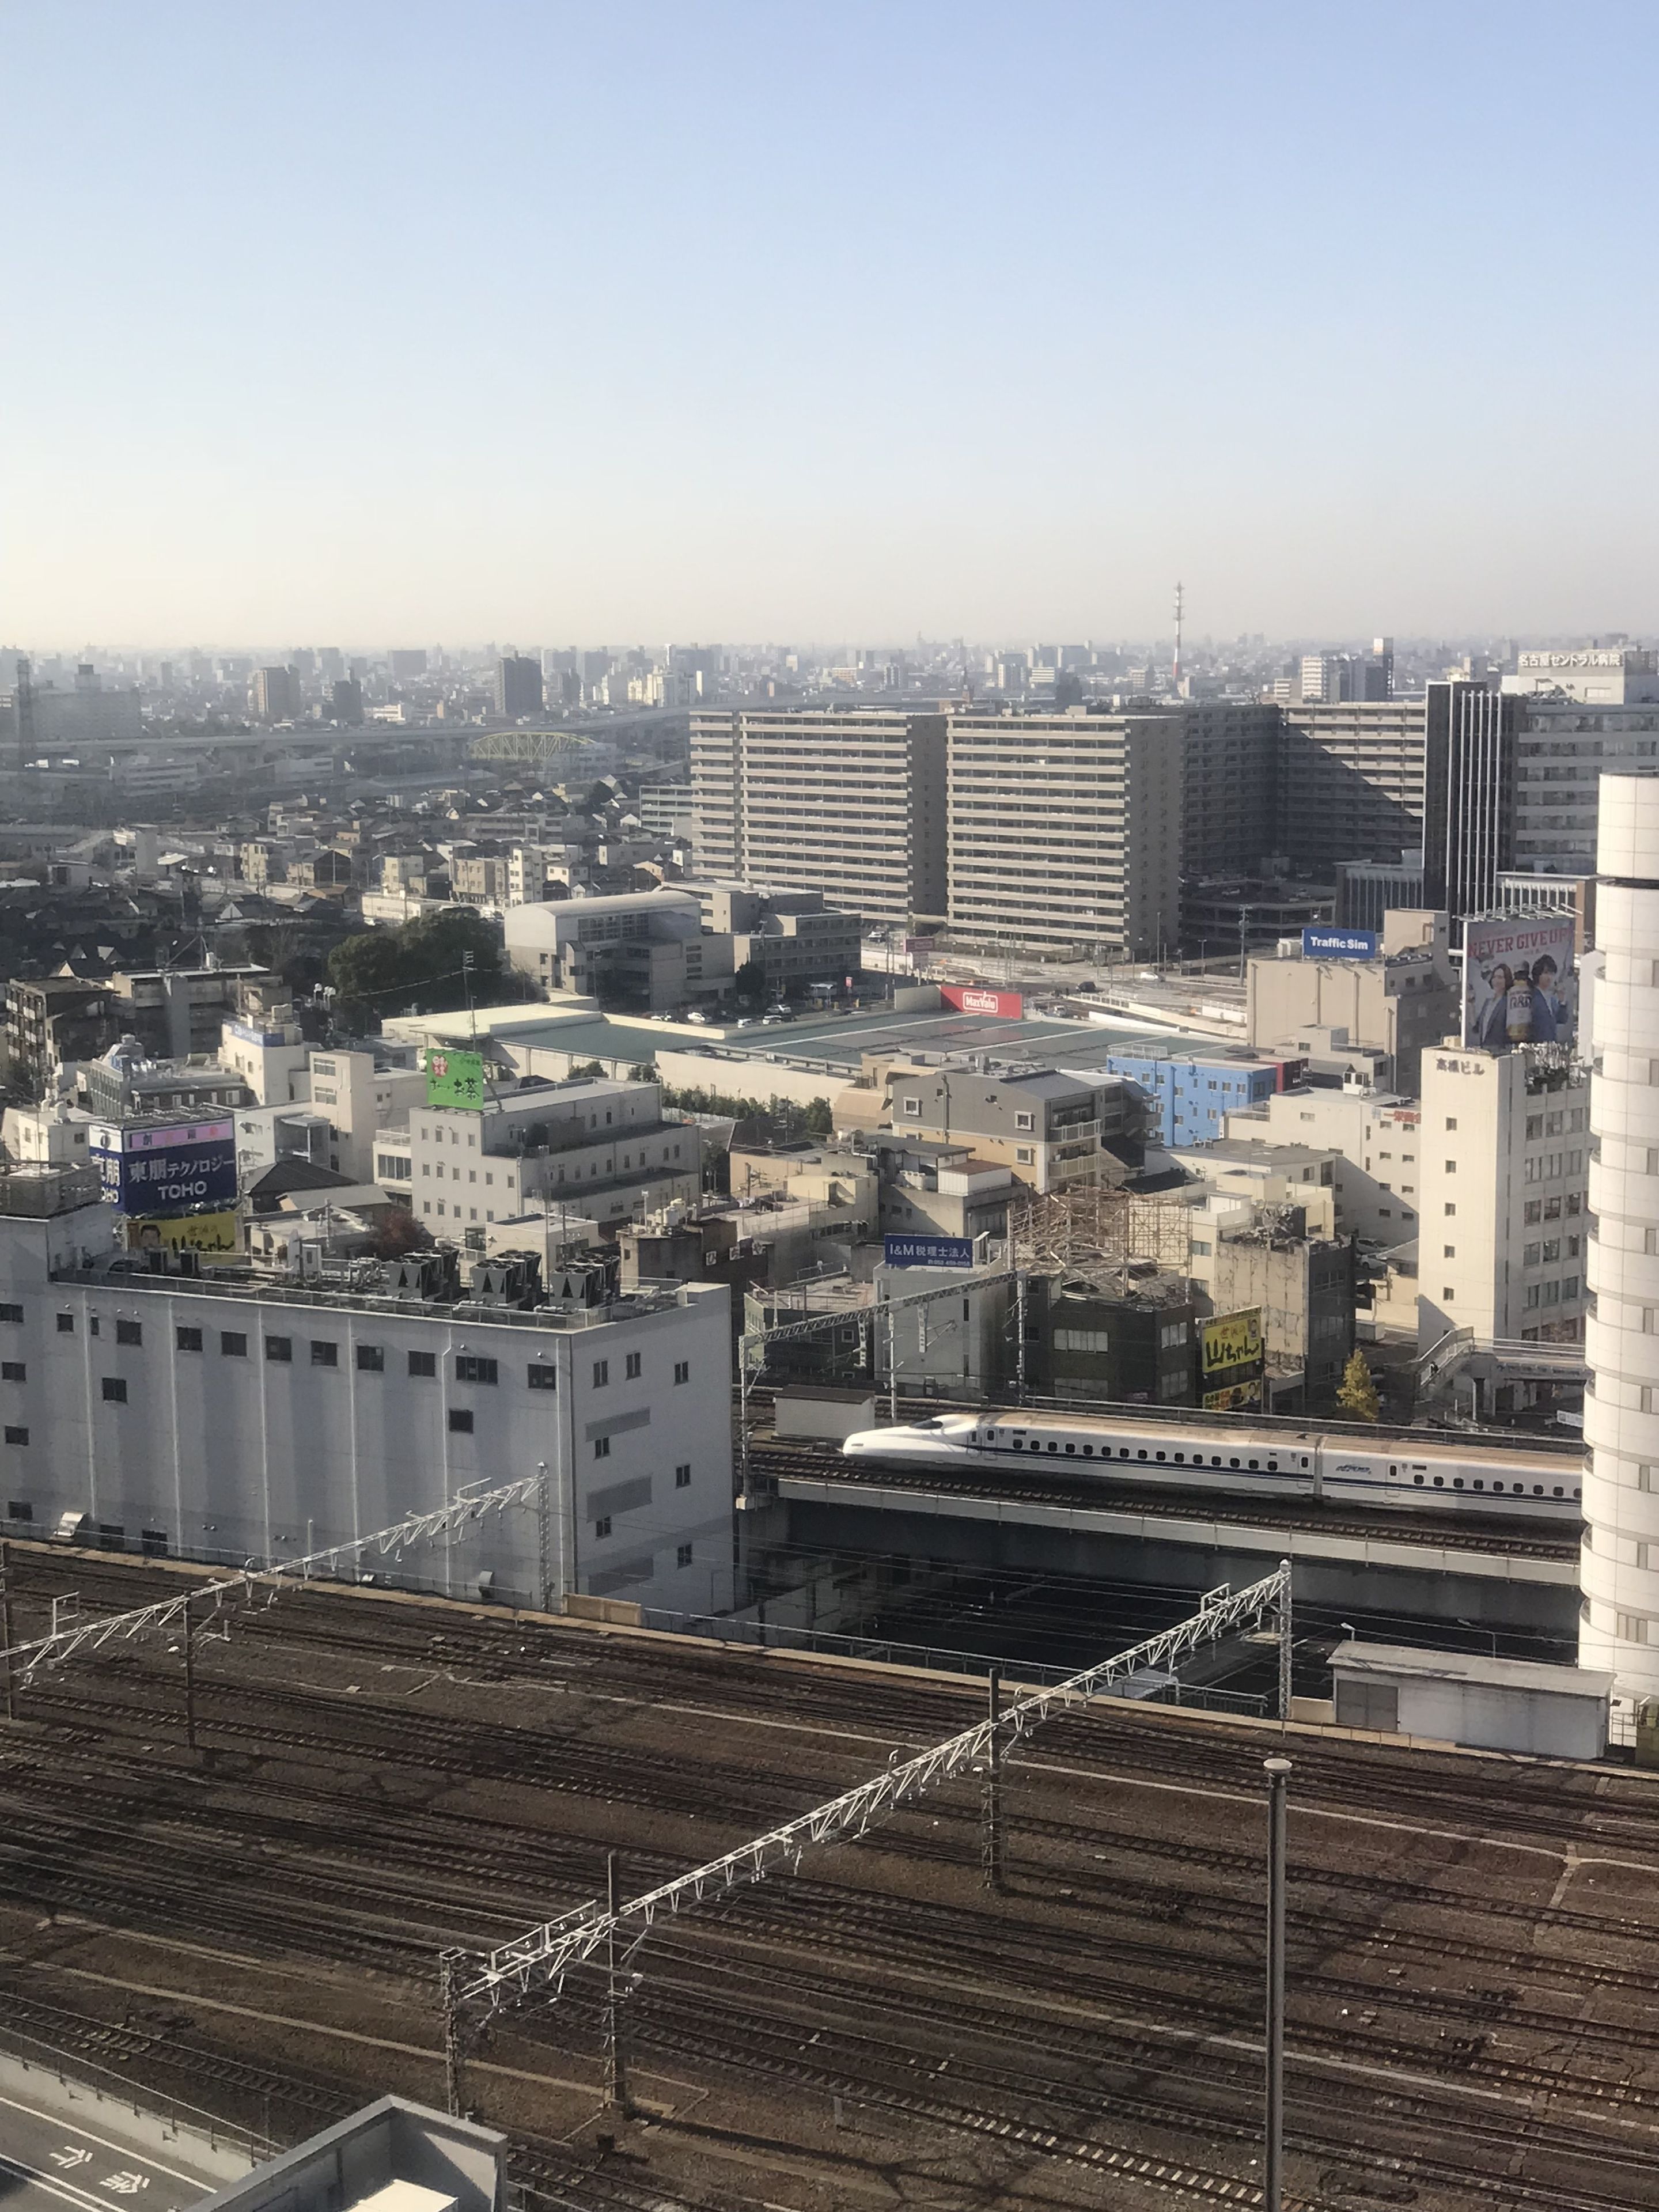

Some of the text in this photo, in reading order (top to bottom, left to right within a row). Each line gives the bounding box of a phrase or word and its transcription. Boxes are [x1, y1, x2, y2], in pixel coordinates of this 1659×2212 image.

[1518, 654, 1621, 667] 名古屋セントラル病院
[1310, 936, 1368, 950] Traffic Sim
[1468, 936, 1514, 957] NEVER
[1517, 930, 1548, 950] GIVE
[965, 991, 996, 1010] MaxValu
[128, 1154, 235, 1183] 東朋テクノロジー
[157, 1180, 208, 1200] TOHO
